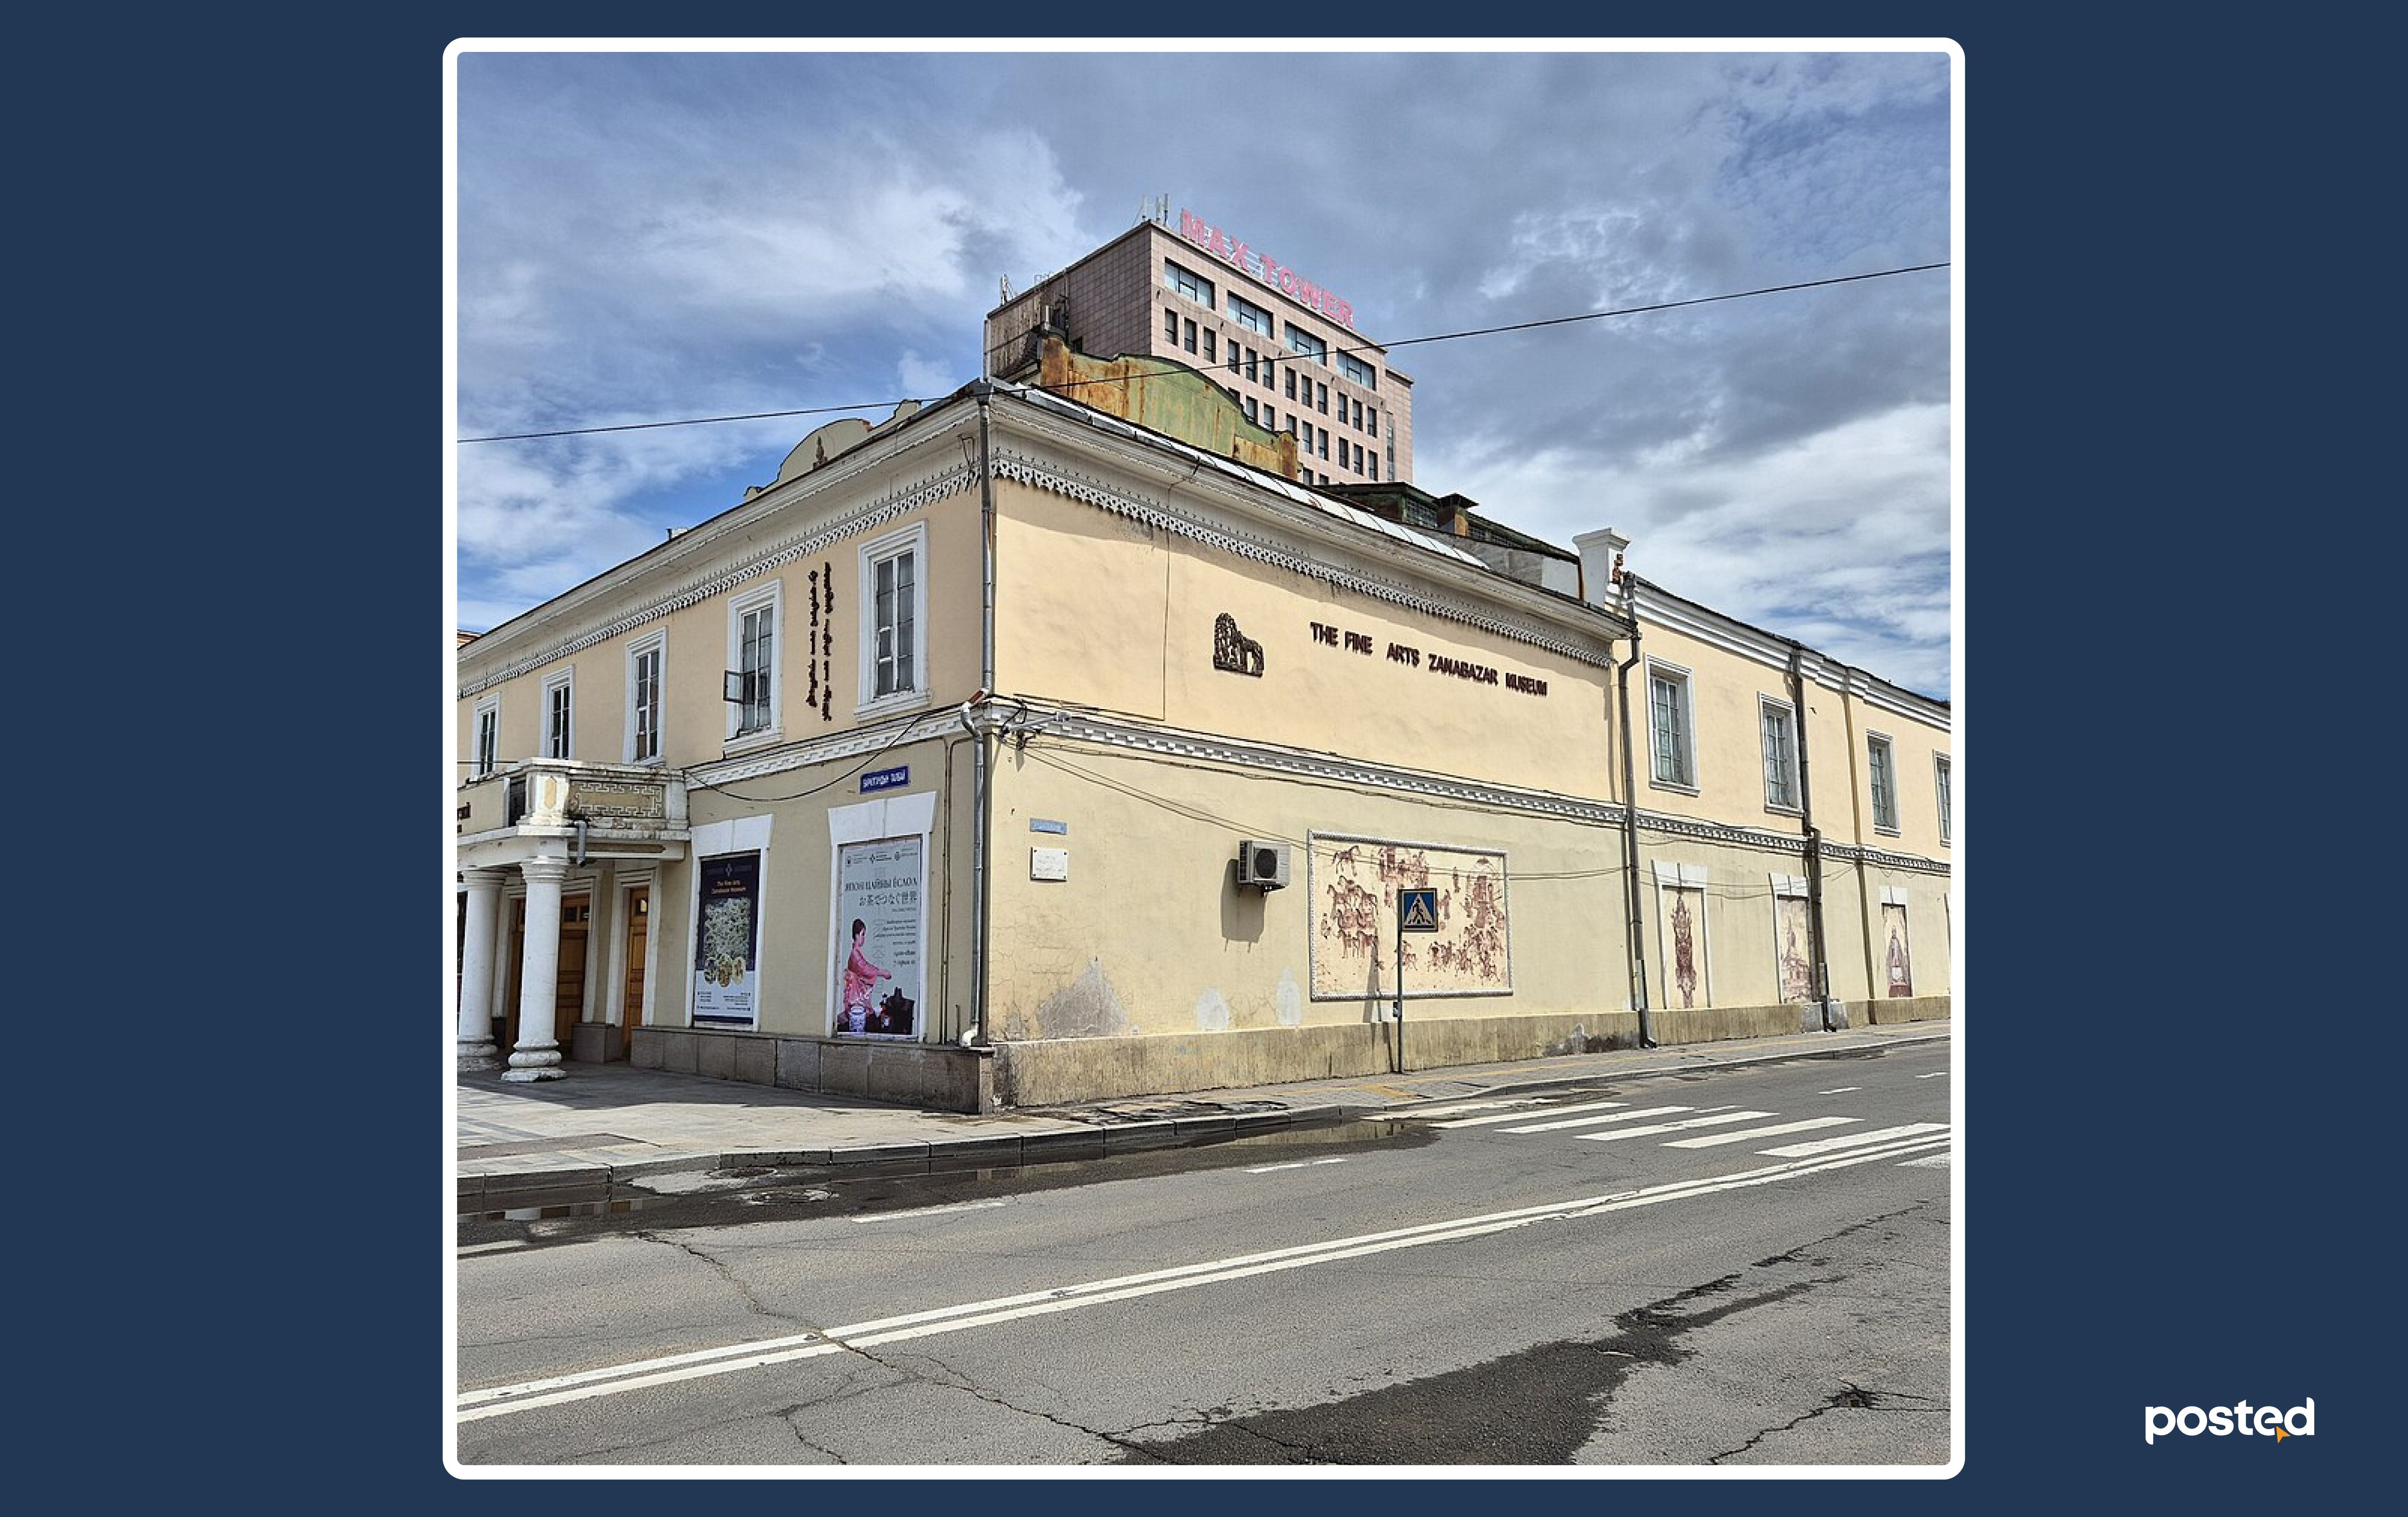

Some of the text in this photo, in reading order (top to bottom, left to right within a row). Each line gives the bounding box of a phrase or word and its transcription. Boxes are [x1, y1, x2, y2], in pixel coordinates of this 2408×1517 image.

[1180, 208, 1353, 328] MAX TOWER
[1310, 622, 1548, 697] THE FINE ARTS ZANABAZAR MUSEUM
